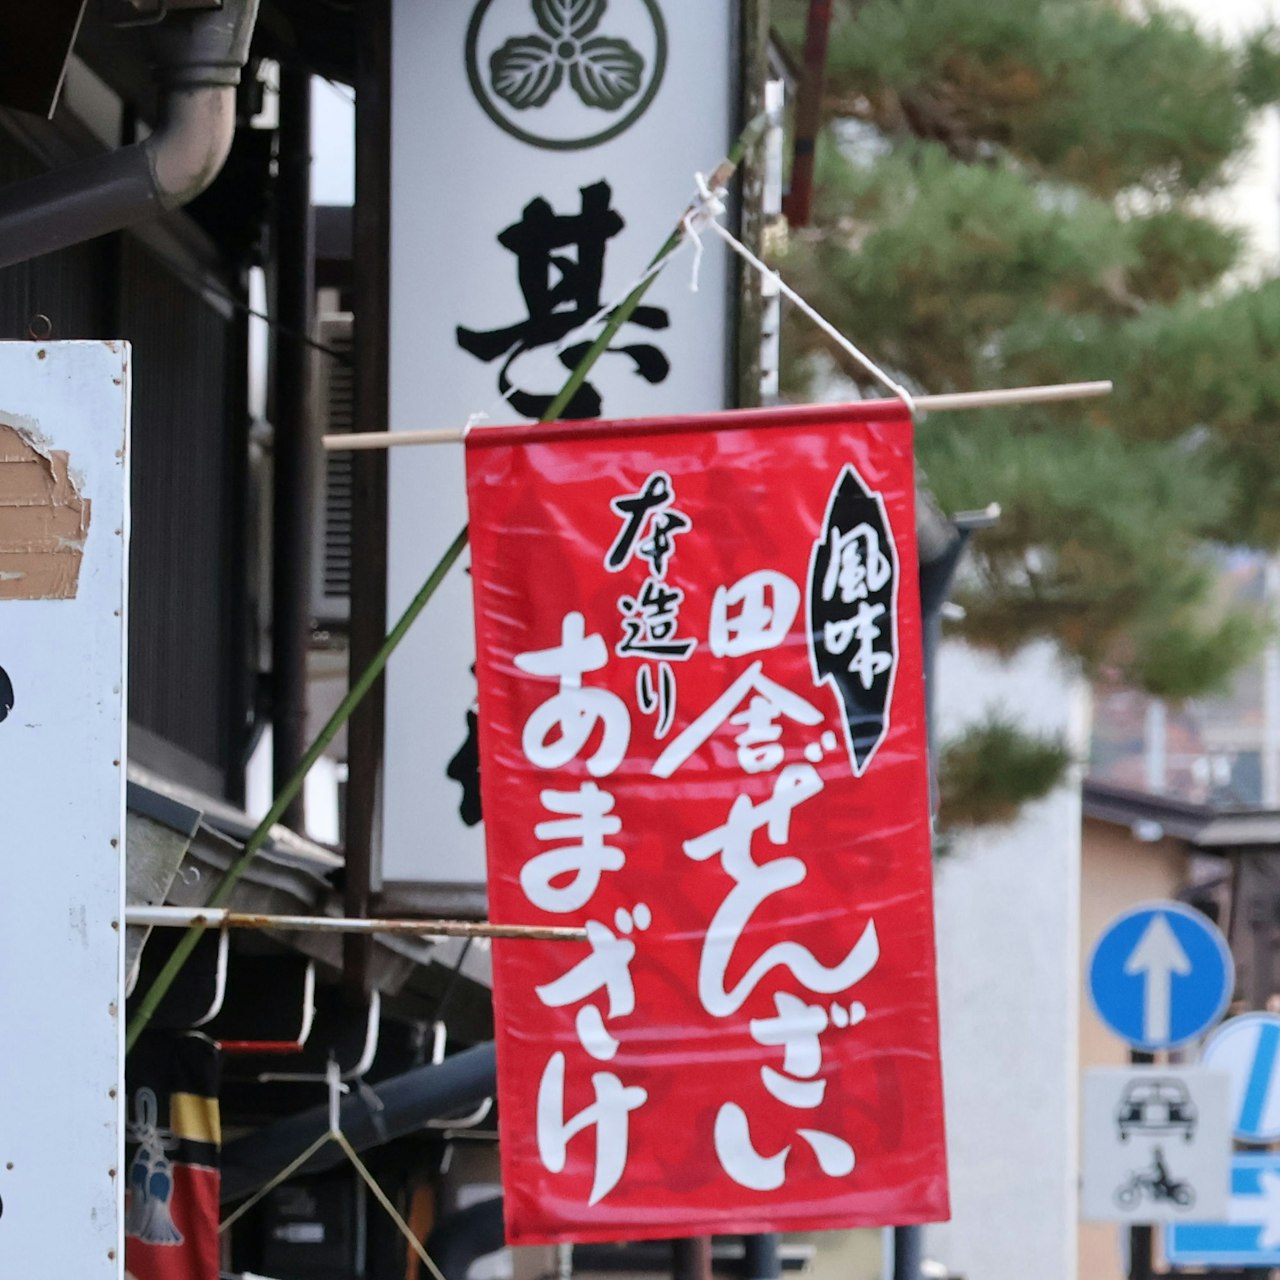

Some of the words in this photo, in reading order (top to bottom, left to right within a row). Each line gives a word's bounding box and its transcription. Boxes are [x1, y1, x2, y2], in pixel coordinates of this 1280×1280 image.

[604, 472, 697, 740] 本造り
[823, 522, 890, 690] 風味
[512, 611, 652, 1206] あまざけ
[652, 570, 880, 1190] 田舎ぜんざい
